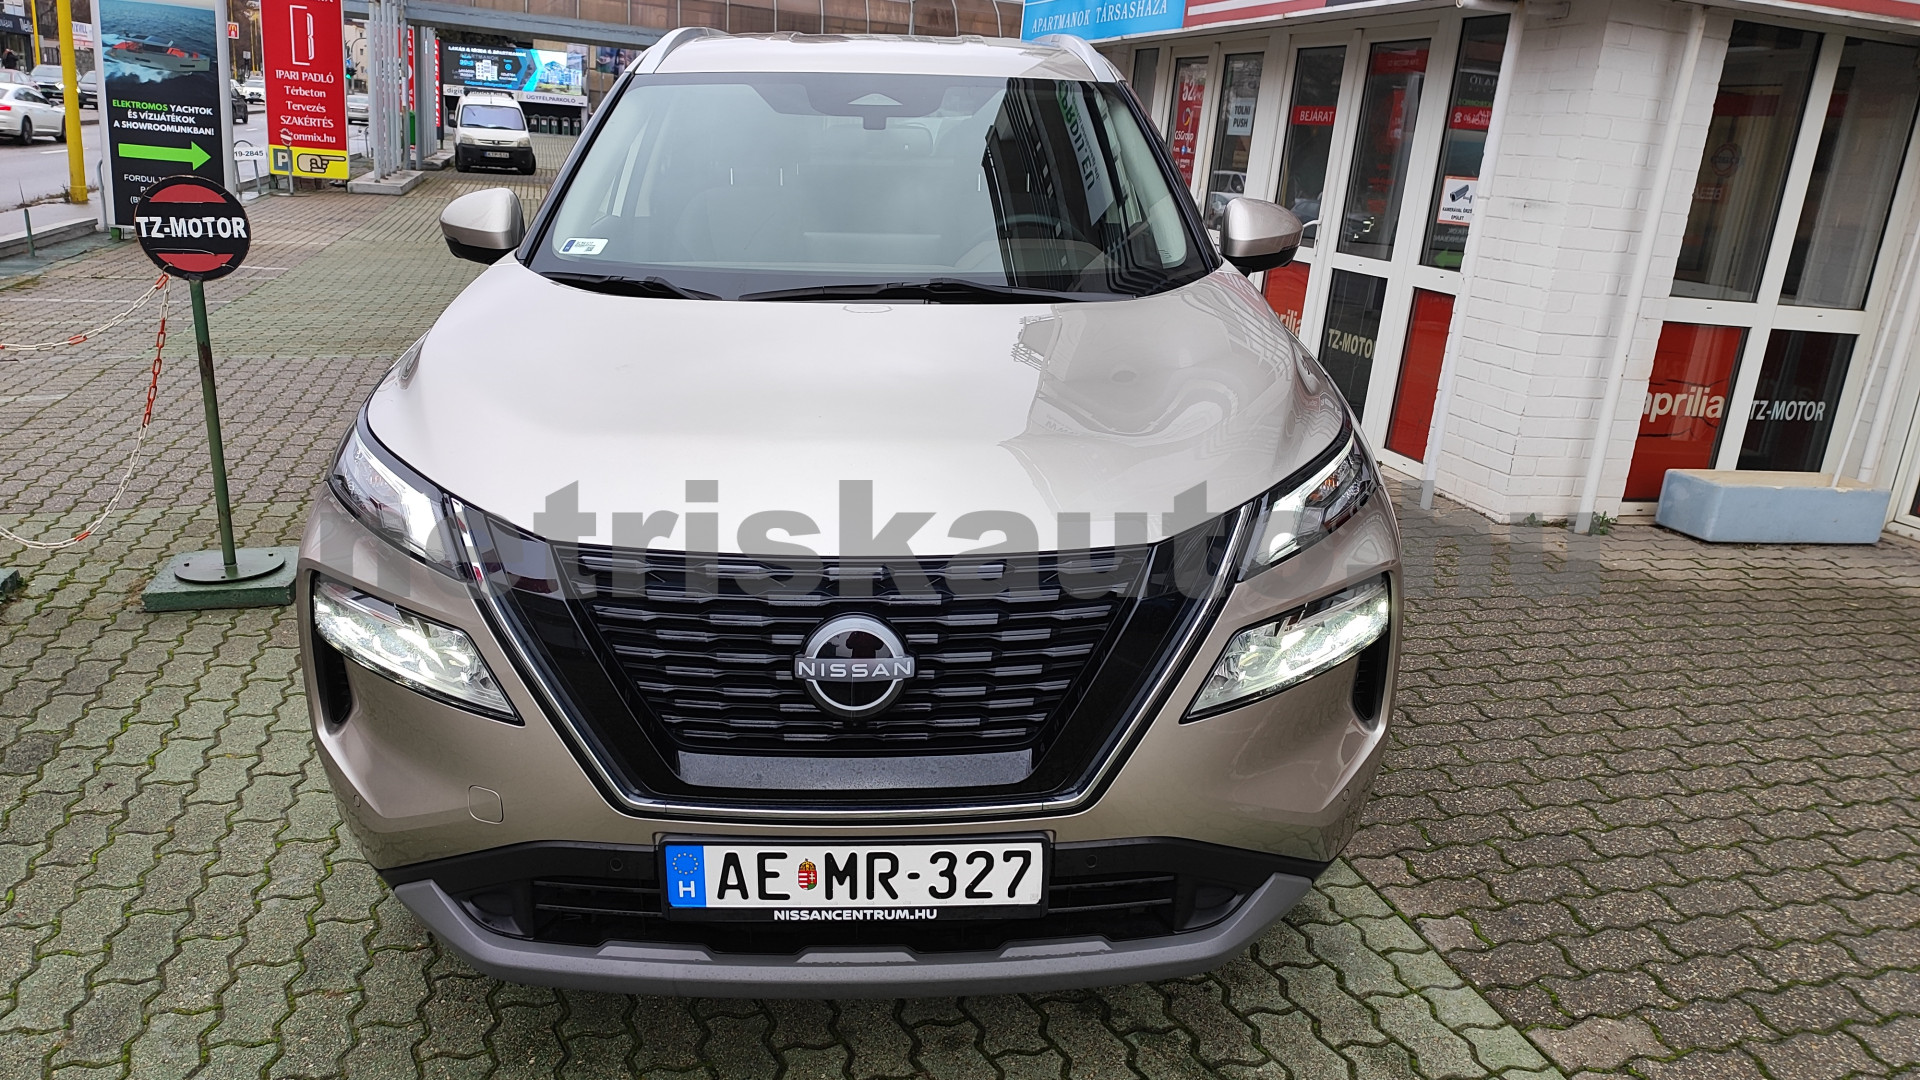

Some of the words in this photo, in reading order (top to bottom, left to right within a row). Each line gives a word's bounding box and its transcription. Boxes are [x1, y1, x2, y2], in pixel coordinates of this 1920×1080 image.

[1031, 9, 1091, 33] APARTMANOK
[275, 69, 300, 80] IPARI
[302, 71, 335, 84] PADLÓ
[284, 85, 327, 98] Térbeton
[112, 98, 168, 112] ELEKTROMOS
[169, 104, 214, 116] YACHTOK
[127, 108, 139, 119] ÉS
[285, 100, 327, 113] Tervezés
[1234, 105, 1251, 116] TOLNI
[280, 114, 335, 129] SZAKÉRTÉS
[1232, 117, 1248, 128] PUSH
[1300, 109, 1334, 123] BEJÁRAT
[113, 119, 121, 128] A
[121, 120, 215, 136] SHOWROOMUNKBAN!
[292, 131, 337, 143] onmix.hu
[277, 151, 288, 167] P
[136, 216, 248, 239] TZ-MOTOR
[1750, 399, 1826, 422] TZ-MOTOR
[797, 658, 914, 677] NISSAN
[716, 851, 791, 900] AE
[824, 849, 1032, 900] MR-327
[679, 881, 696, 898] H
[773, 909, 938, 921] NISSANCENTRUM.HU
